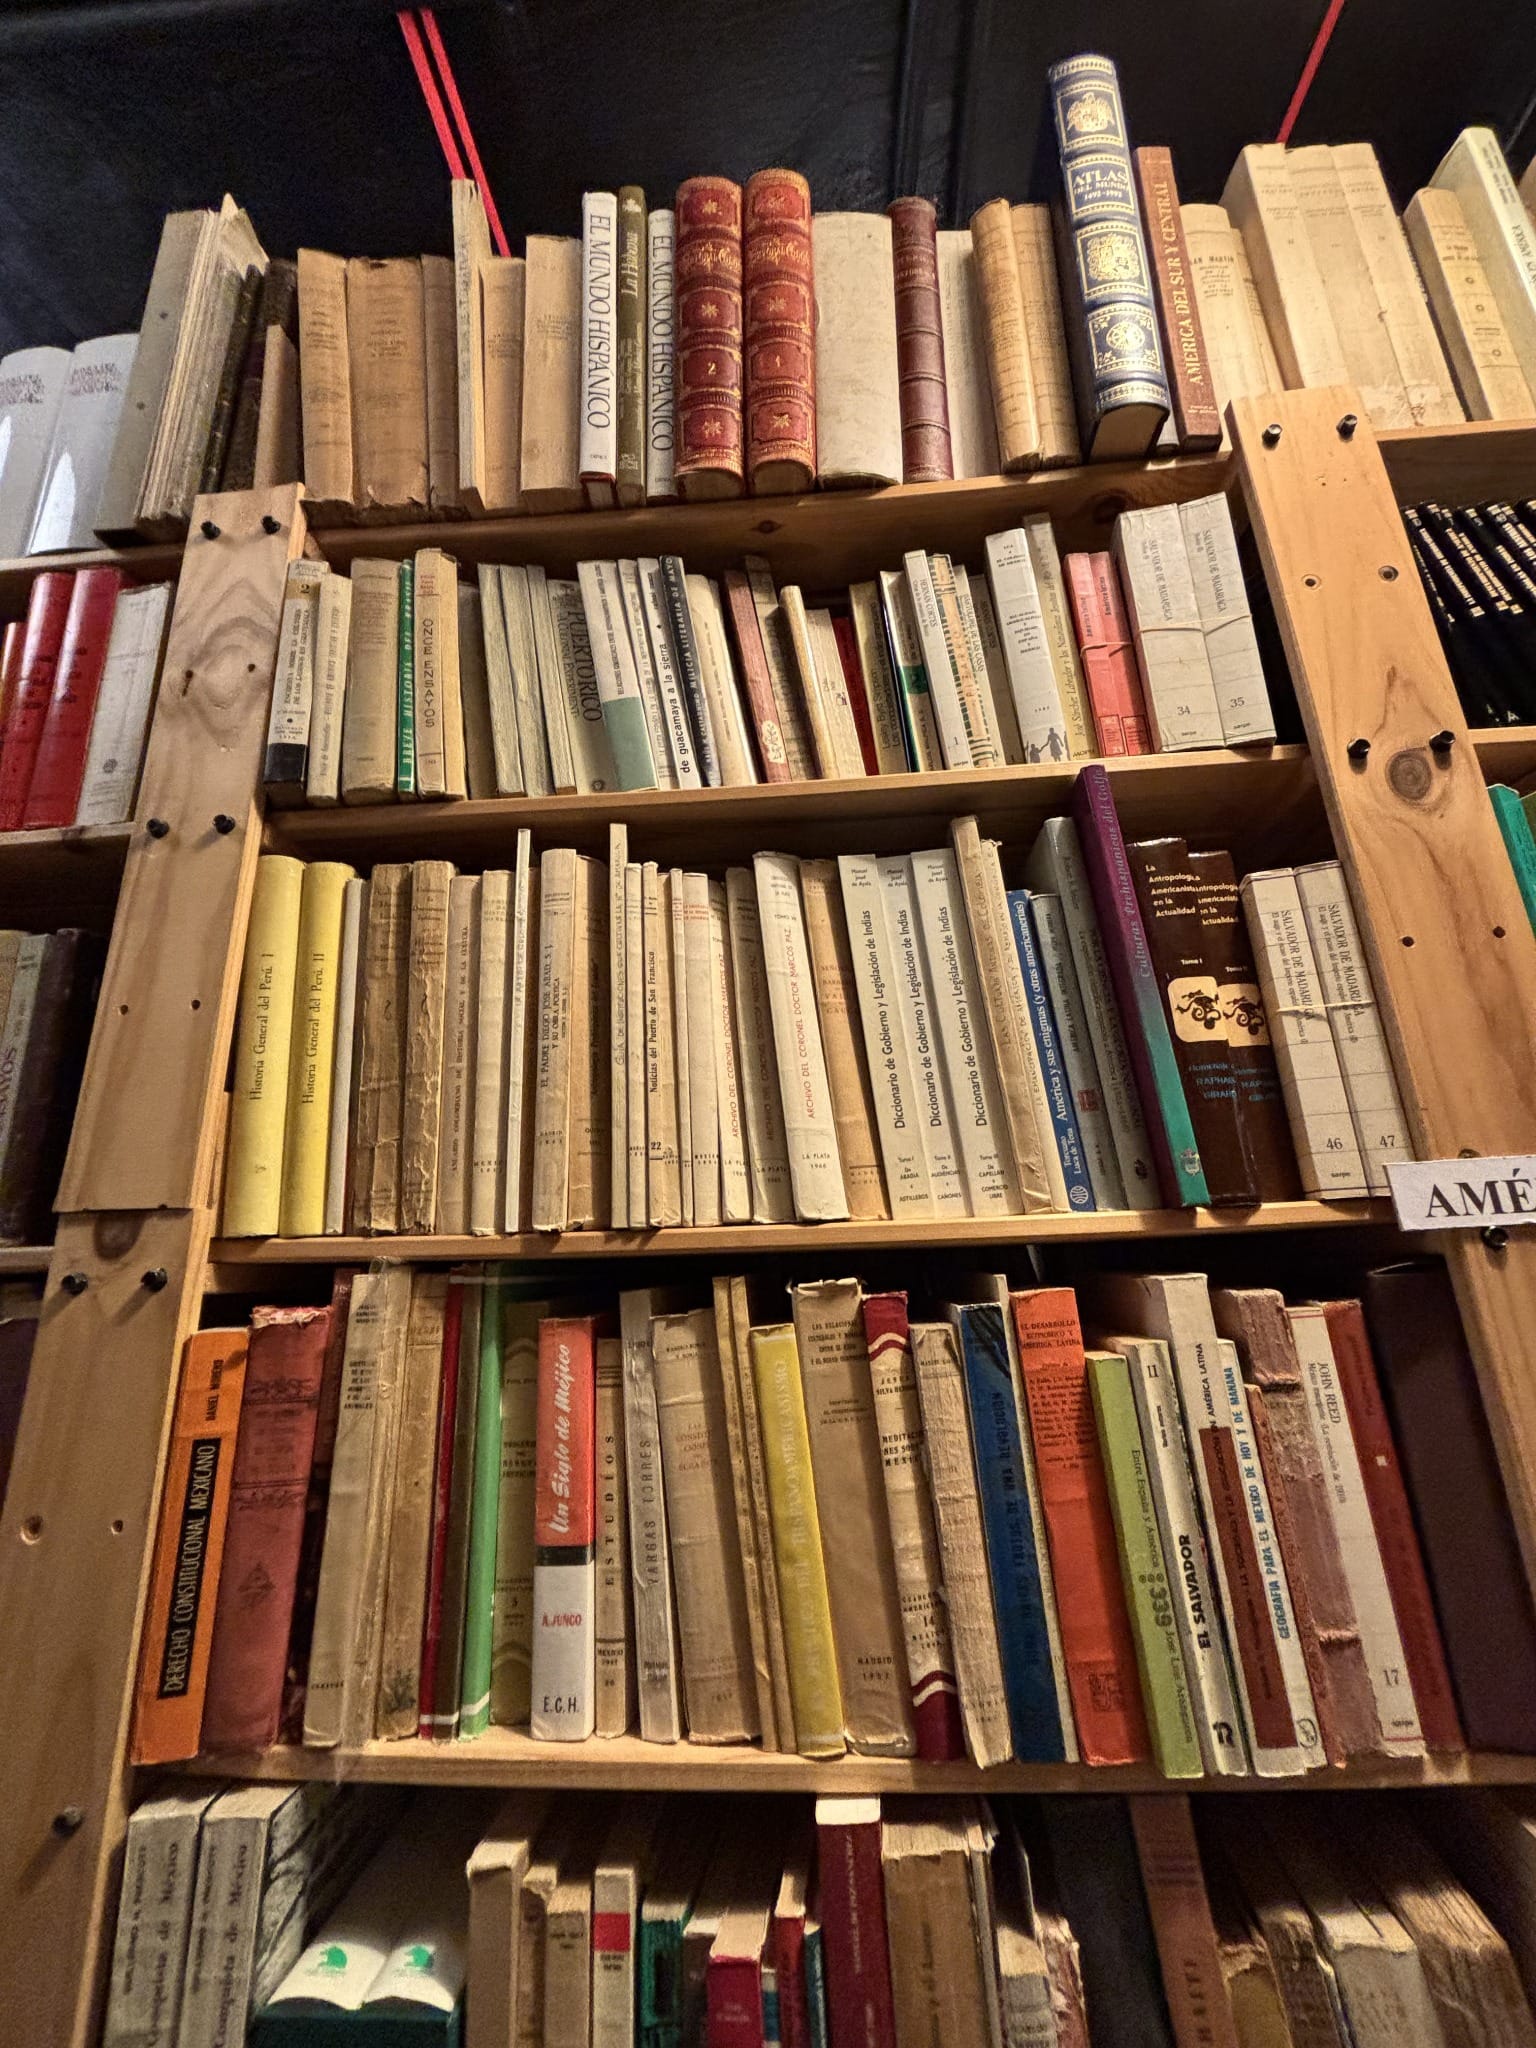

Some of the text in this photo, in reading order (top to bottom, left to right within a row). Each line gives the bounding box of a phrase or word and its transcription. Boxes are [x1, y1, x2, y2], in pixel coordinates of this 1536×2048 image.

[1073, 168, 1128, 187] ATLAS
[590, 213, 611, 233] EL
[1156, 181, 1179, 243] CENTRAL
[653, 235, 673, 258] EL
[588, 238, 611, 314] MUNDO
[1167, 256, 1185, 285] SUR
[621, 279, 639, 298] La
[651, 261, 673, 340] MUNDO
[1174, 285, 1191, 315] DEL
[775, 355, 780, 368] 1
[1180, 319, 1205, 386] AMERICA
[587, 317, 612, 429] HISPÁNICO
[707, 362, 717, 376] 2
[301, 584, 310, 594] 2
[674, 603, 690, 648] LITERARIA
[568, 611, 603, 722] PUERTO RICO
[658, 643, 671, 670] sierra
[423, 619, 435, 728] ONCE ENSAYOS
[662, 674, 673, 684] la
[684, 652, 698, 689] MILICIA
[403, 663, 414, 717] HISTORIA
[1230, 697, 1246, 709] 35
[1177, 706, 1191, 716] 34
[669, 698, 689, 754] guacamaya
[403, 729, 413, 764] BREVE
[680, 760, 691, 773] de
[1096, 772, 1110, 803] Golfo
[1103, 804, 1115, 826] del
[862, 909, 871, 935] Indias
[898, 909, 908, 935] Indias
[938, 905, 949, 930] Indias
[1156, 906, 1195, 917] Actualidad
[785, 929, 793, 943] PAZ
[866, 935, 876, 949] de
[903, 935, 911, 948] de
[944, 931, 953, 945] de
[1133, 920, 1150, 978] Culturas
[313, 953, 325, 961] II
[789, 945, 800, 979] MARCOS
[1280, 910, 1317, 1021] SALVADOR DE MADARIGA
[1327, 904, 1365, 1017] SALVADOR DE MADARIGA
[868, 952, 884, 999] Legislación
[905, 951, 922, 998] Legislación
[947, 948, 963, 996] Legislación
[1029, 968, 1041, 992] otras
[257, 996, 270, 1011] del
[543, 991, 551, 1010] JOSE
[552, 977, 560, 1006] POETICA
[794, 985, 805, 1016] DOCTOR
[309, 998, 321, 1013] del
[253, 1014, 268, 1056] General
[306, 1017, 319, 1059] General
[542, 1014, 550, 1040] DIEGO
[552, 1032, 558, 1041] SU
[649, 1016, 657, 1041] Puerto
[797, 1020, 809, 1058] CORONEL
[880, 1012, 893, 1054] Gobierno
[916, 1011, 929, 1053] Gobierno
[960, 1008, 973, 1052] Gobierno
[1037, 1005, 1053, 1047] enigmas
[541, 1045, 549, 1073] PADRE
[649, 1043, 657, 1058] del
[886, 1057, 895, 1071] de
[922, 1055, 931, 1069] de
[965, 1054, 976, 1068] de
[1045, 1049, 1056, 1067] sus
[250, 1057, 264, 1100] Historia
[302, 1060, 316, 1105] Historia
[541, 1077, 548, 1087] EL
[649, 1061, 658, 1093] Noticias
[807, 1081, 816, 1120] ARCHIVO
[886, 1074, 906, 1128] Diccionario
[922, 1073, 942, 1127] Diccionario
[967, 1072, 987, 1126] Diccionario
[1049, 1076, 1069, 1122] América
[650, 1141, 662, 1150] 22
[1066, 1128, 1078, 1145] Tena
[1326, 1138, 1343, 1150] 46
[1379, 1135, 1396, 1147] 47
[1061, 1135, 1073, 1167] Torcuato
[1071, 1156, 1083, 1174] Luca
[1425, 1168, 1536, 1218] AMÉ
[1031, 1320, 1076, 1329] DESARROLLO
[1056, 1340, 1080, 1348] LATINA
[1318, 1362, 1342, 1424] JOHN REED
[205, 1396, 220, 1422] DANIEL
[1233, 1410, 1244, 1424] DE
[549, 1343, 574, 1534] Un Siglo de Méjico
[1239, 1440, 1252, 1461] HOY
[1244, 1464, 1256, 1479] DE
[604, 1435, 615, 1586] ESTUDIOS
[640, 1438, 660, 1586] VARGAS TORRES
[1249, 1485, 1265, 1523] MEXICO
[1130, 1448, 1146, 1482] Entre
[1143, 1529, 1160, 1569] América
[1152, 1584, 1172, 1628] 339
[1258, 1528, 1268, 1542] EL
[162, 1444, 216, 1695] DERECHO CONSTITUCIONAL MEXICANO
[1262, 1546, 1275, 1574] PARA
[1177, 1533, 1211, 1650] EL SALVADOR
[923, 1615, 935, 1627] 14
[1268, 1577, 1291, 1641] GEOGRAFIA
[857, 1656, 892, 1665] MADRID
[1383, 1669, 1400, 1686] 17
[155, 1919, 171, 1942] de
[223, 1922, 239, 1945] de
